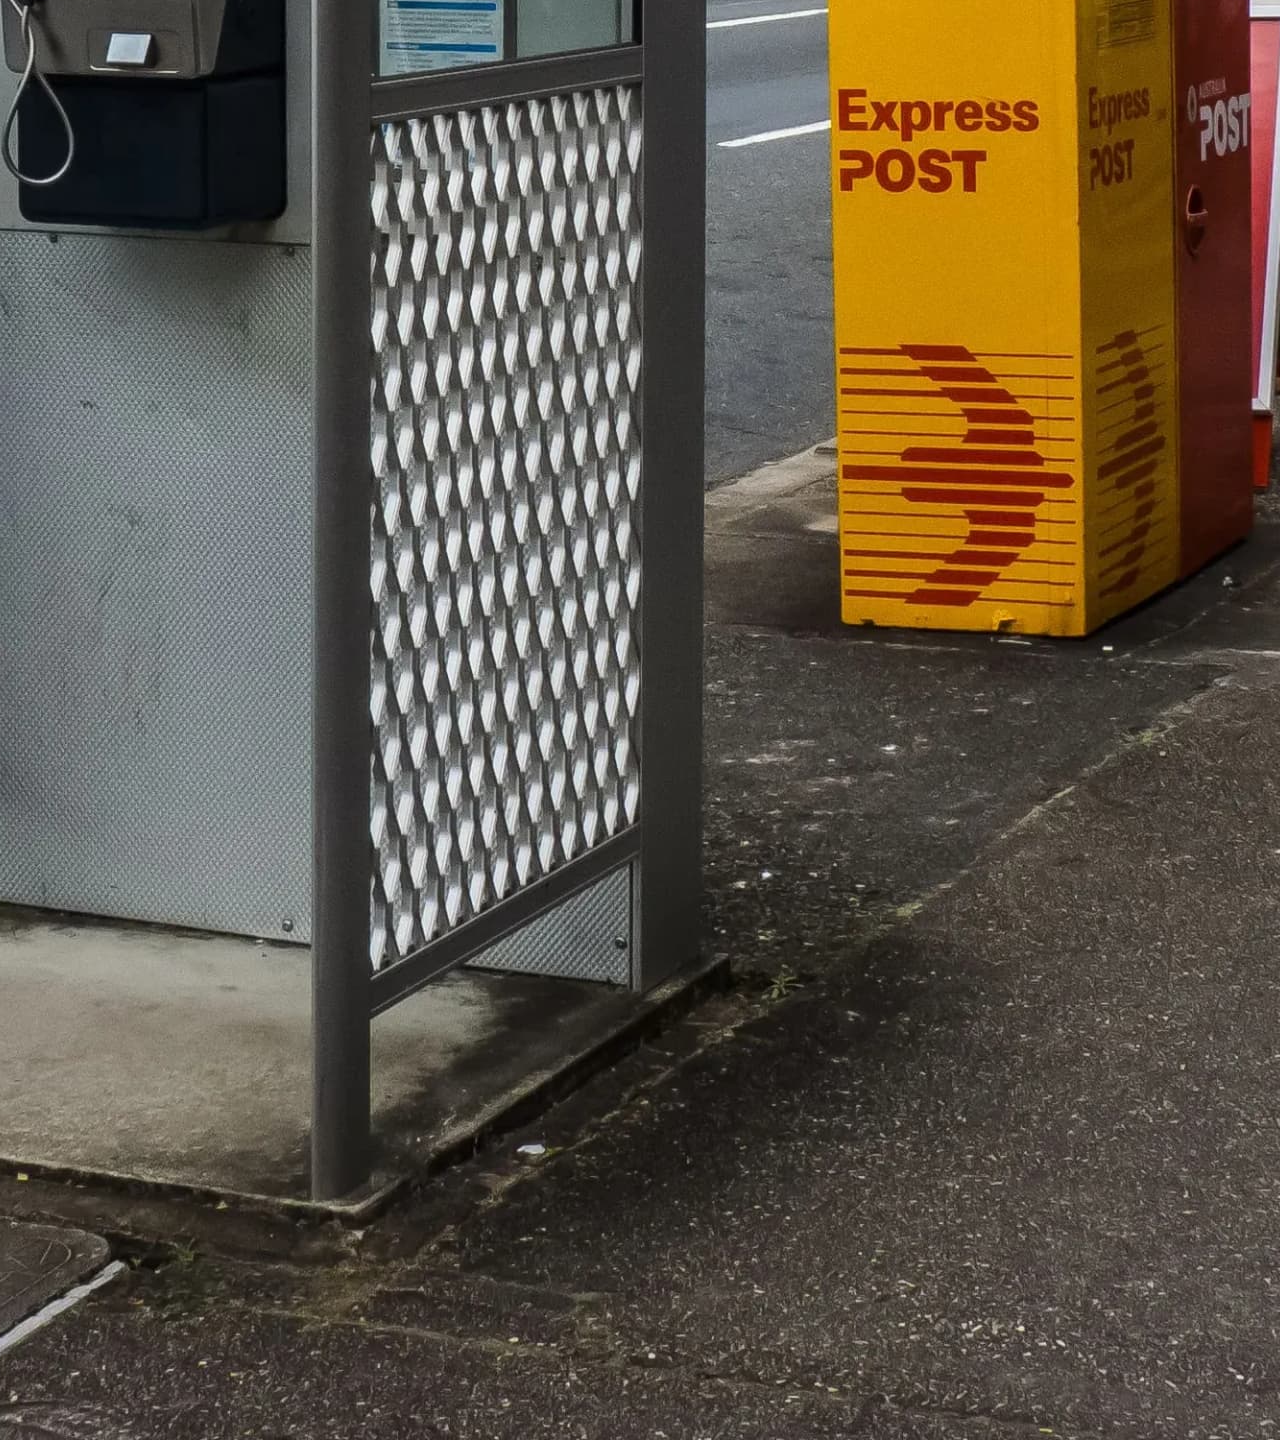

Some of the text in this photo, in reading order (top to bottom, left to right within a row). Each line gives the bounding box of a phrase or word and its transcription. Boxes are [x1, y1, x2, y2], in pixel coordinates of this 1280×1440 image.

[838, 88, 1040, 142] Express
[1088, 86, 1150, 136] Express
[1200, 93, 1251, 162] POST
[839, 148, 987, 193] POST
[1090, 139, 1135, 191] POST
